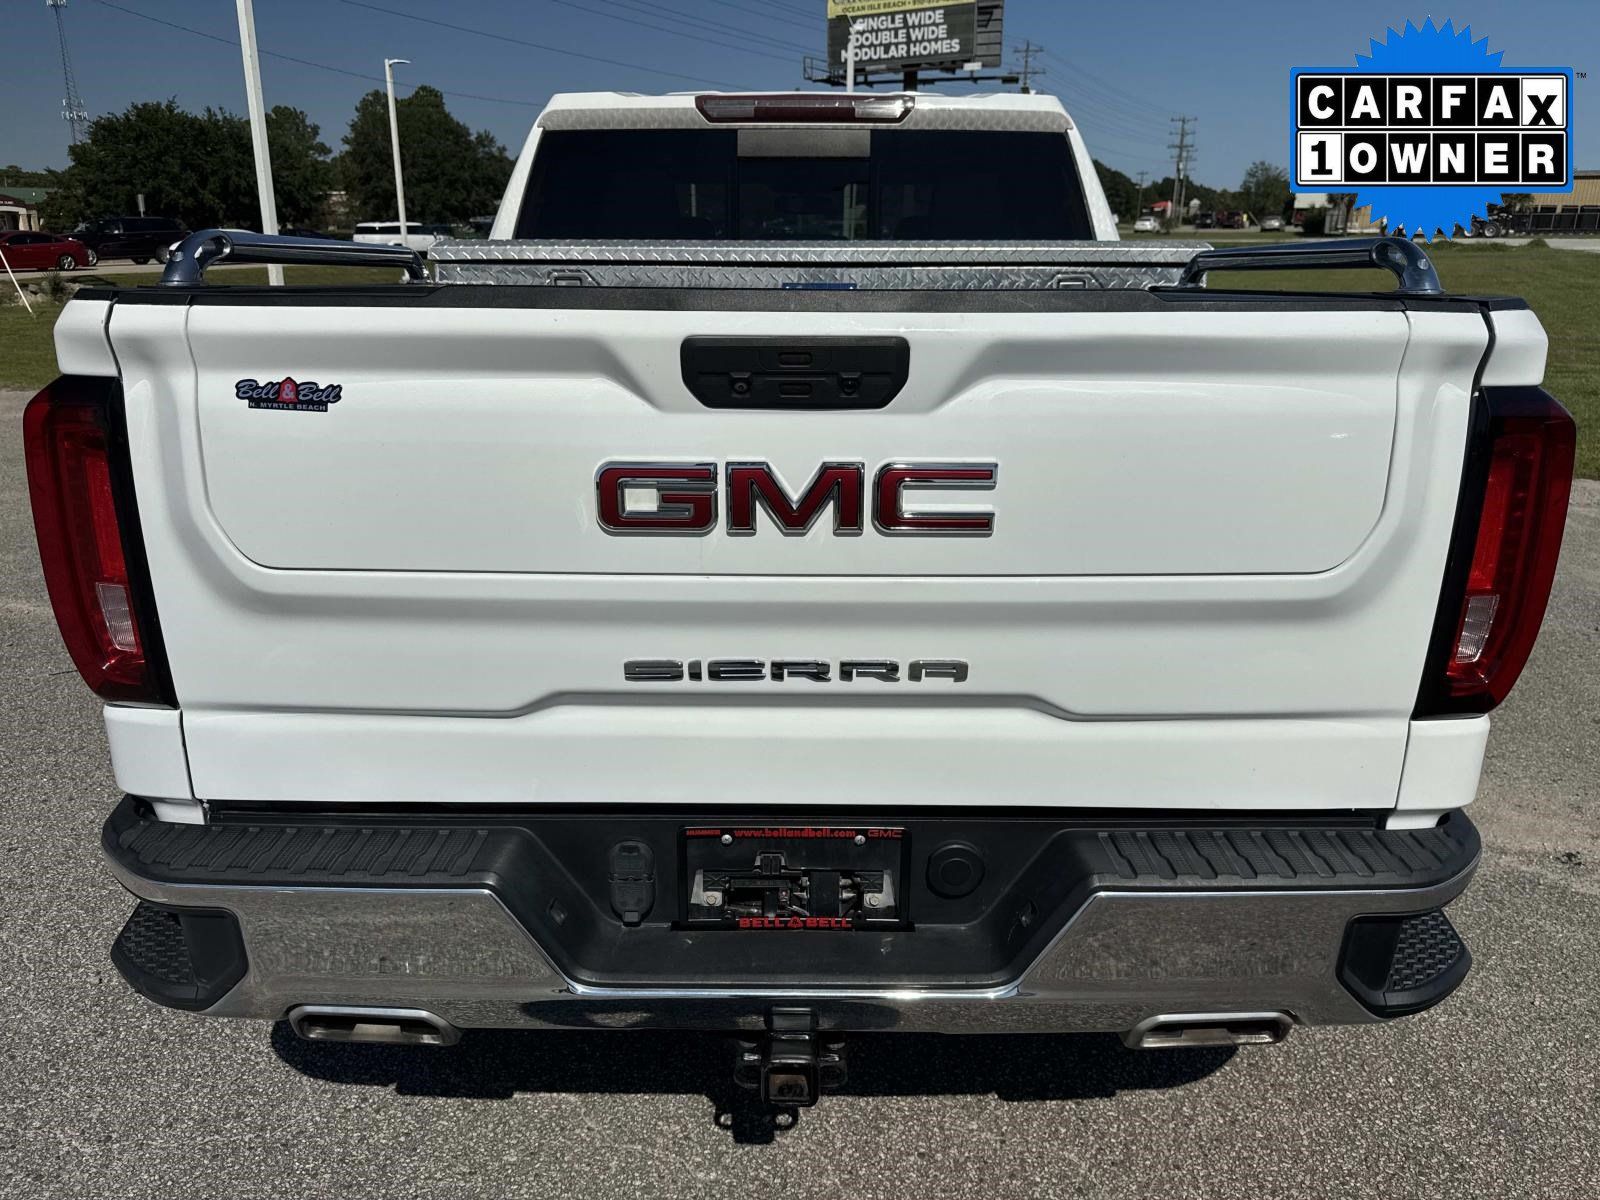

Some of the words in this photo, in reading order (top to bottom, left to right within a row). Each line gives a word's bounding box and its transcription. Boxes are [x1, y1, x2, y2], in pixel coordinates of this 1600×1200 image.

[842, 5, 866, 13] OCEAN
[883, 1, 906, 9] BEACH
[906, 10, 945, 26] WIDE
[852, 29, 907, 46] DOUBLE
[909, 25, 948, 41] WIDE
[909, 39, 961, 56] HOMES
[236, 380, 280, 399] Bell
[282, 383, 294, 399] &
[298, 383, 341, 402] Bell
[297, 403, 326, 411] BEACH
[595, 460, 999, 537] GMC
[623, 658, 969, 682] SIERRA
[734, 828, 856, 838] www.bellandbell.com
[867, 829, 902, 838] GMC
[740, 917, 784, 928] BELL
[806, 917, 852, 928] BELL
